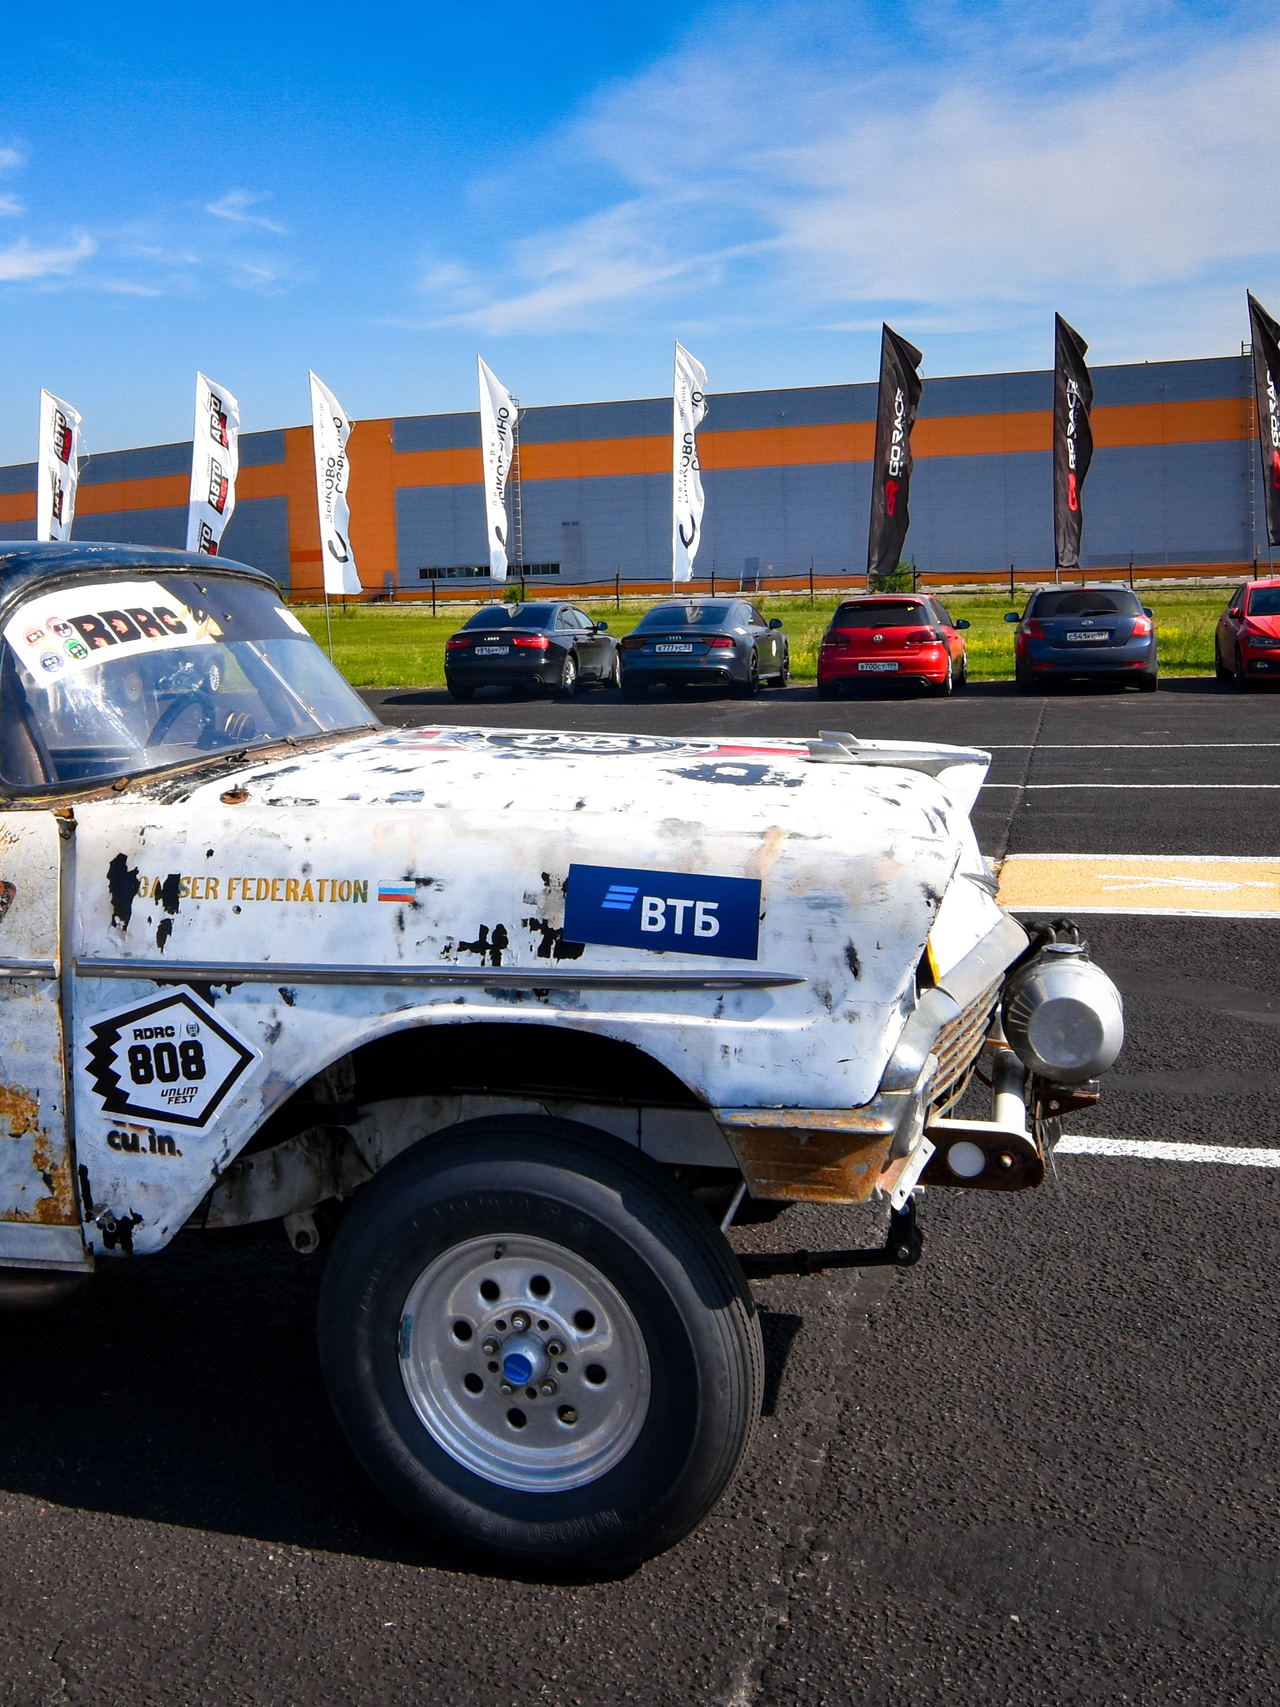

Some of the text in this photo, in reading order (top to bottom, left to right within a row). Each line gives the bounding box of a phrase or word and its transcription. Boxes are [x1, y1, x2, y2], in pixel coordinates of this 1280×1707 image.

[209, 460, 222, 506] АВТО
[227, 876, 369, 903] FEDERATION
[639, 894, 720, 938] ВТБ
[133, 1025, 176, 1040] RDRC
[128, 1039, 207, 1085] 808
[167, 1095, 195, 1105] FEST
